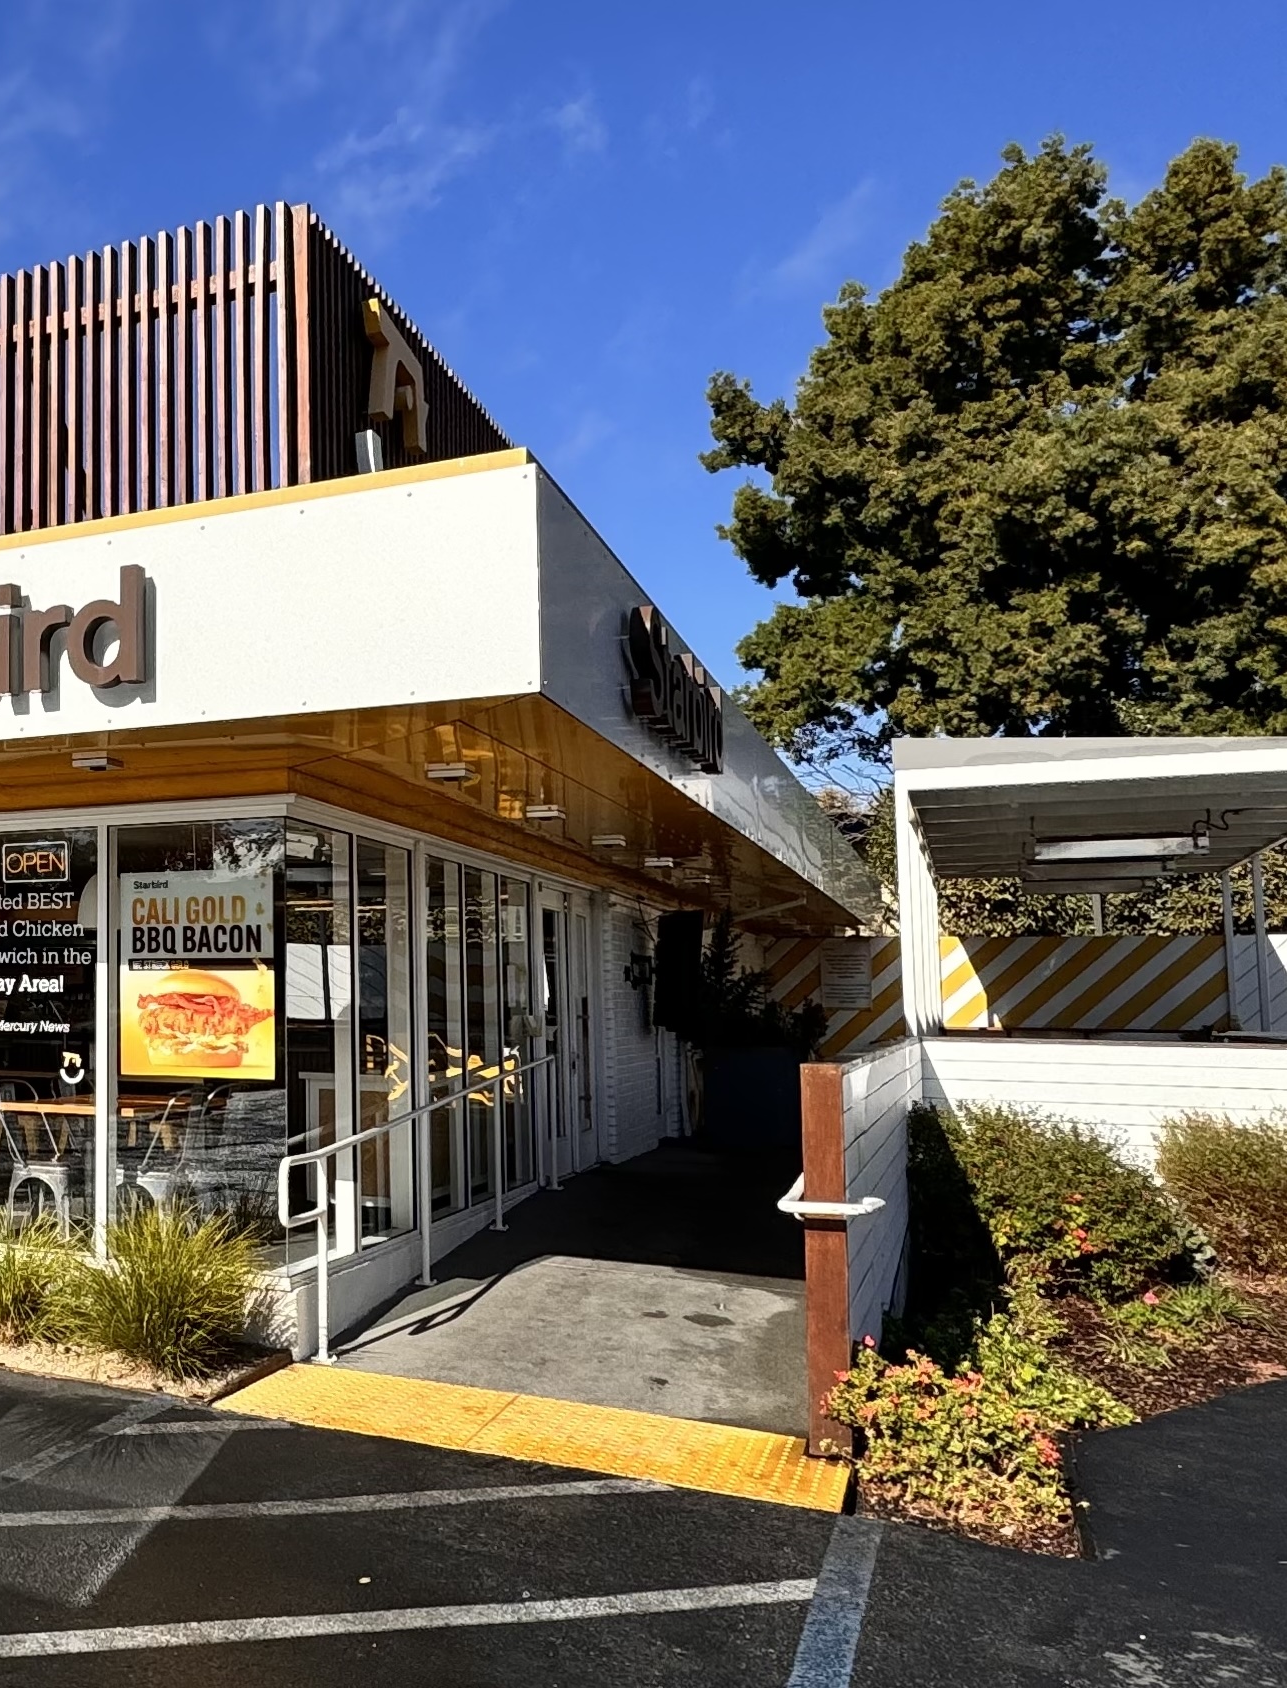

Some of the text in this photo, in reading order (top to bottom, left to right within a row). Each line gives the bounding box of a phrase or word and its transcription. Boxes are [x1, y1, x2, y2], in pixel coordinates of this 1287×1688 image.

[6, 852, 66, 874] OPEN
[133, 880, 169, 889] Starbird
[27, 892, 74, 909] BEST
[132, 895, 246, 925] CALI GOLD
[12, 920, 85, 937] Chicken
[132, 924, 262, 954] BBQ BACON
[42, 948, 59, 964] in
[63, 948, 92, 964] the
[18, 974, 64, 993] Area!
[38, 1020, 71, 1033] News
